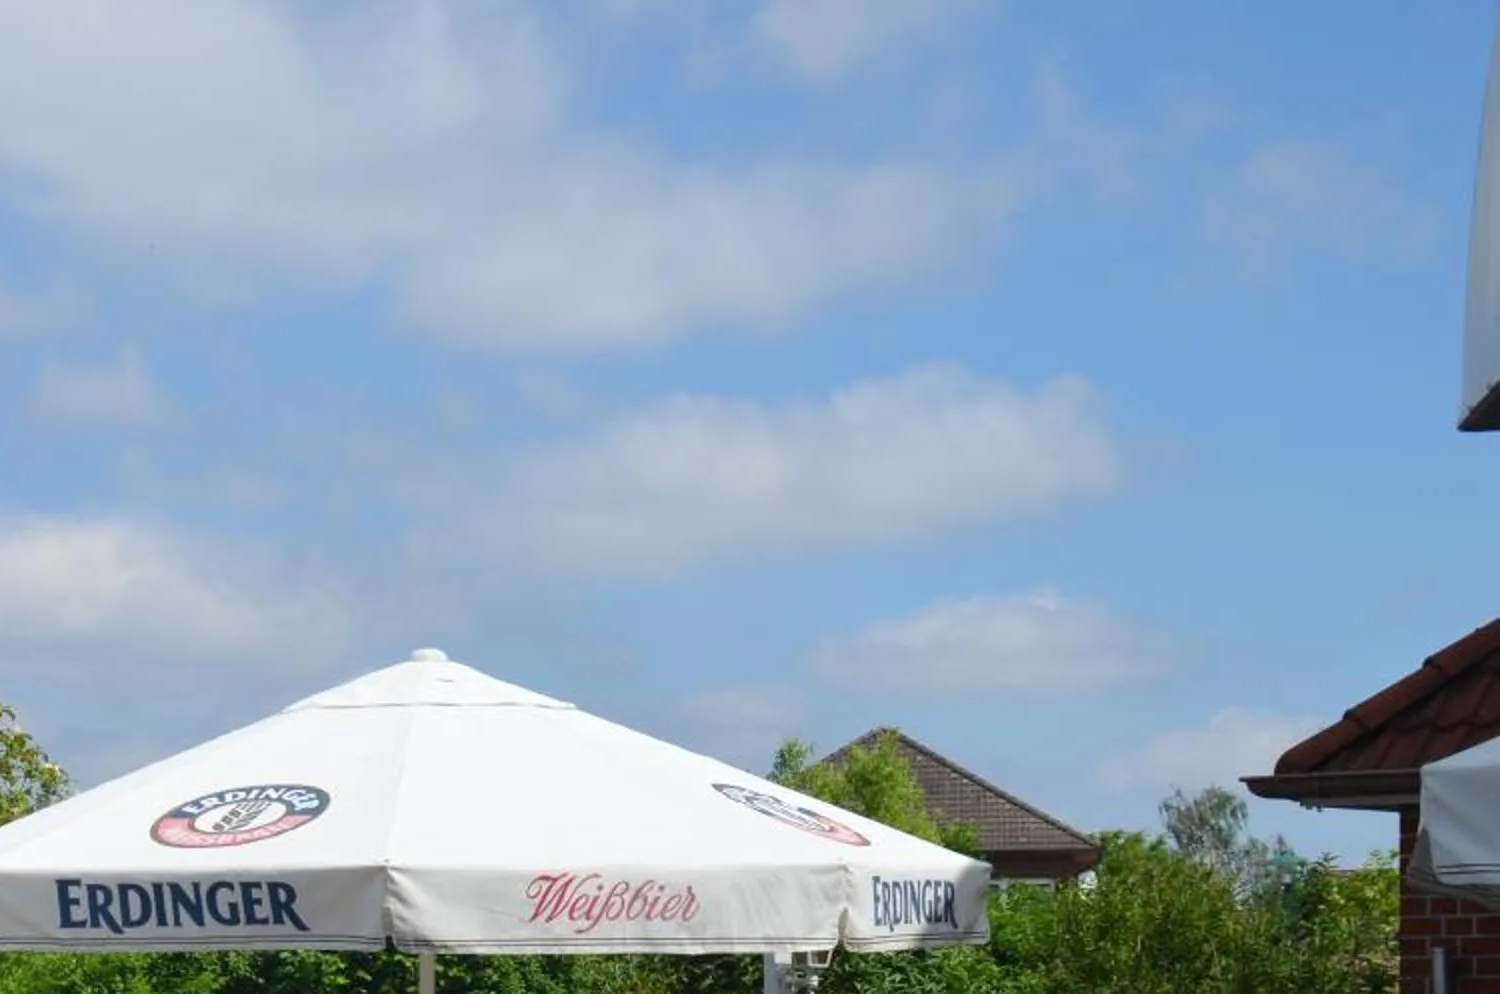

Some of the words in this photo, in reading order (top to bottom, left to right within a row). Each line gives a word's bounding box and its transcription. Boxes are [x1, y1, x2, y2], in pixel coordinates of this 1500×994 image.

[55, 878, 311, 934] ERDINGER
[525, 872, 699, 933] Weißbier
[871, 876, 959, 932] ERDINGER
